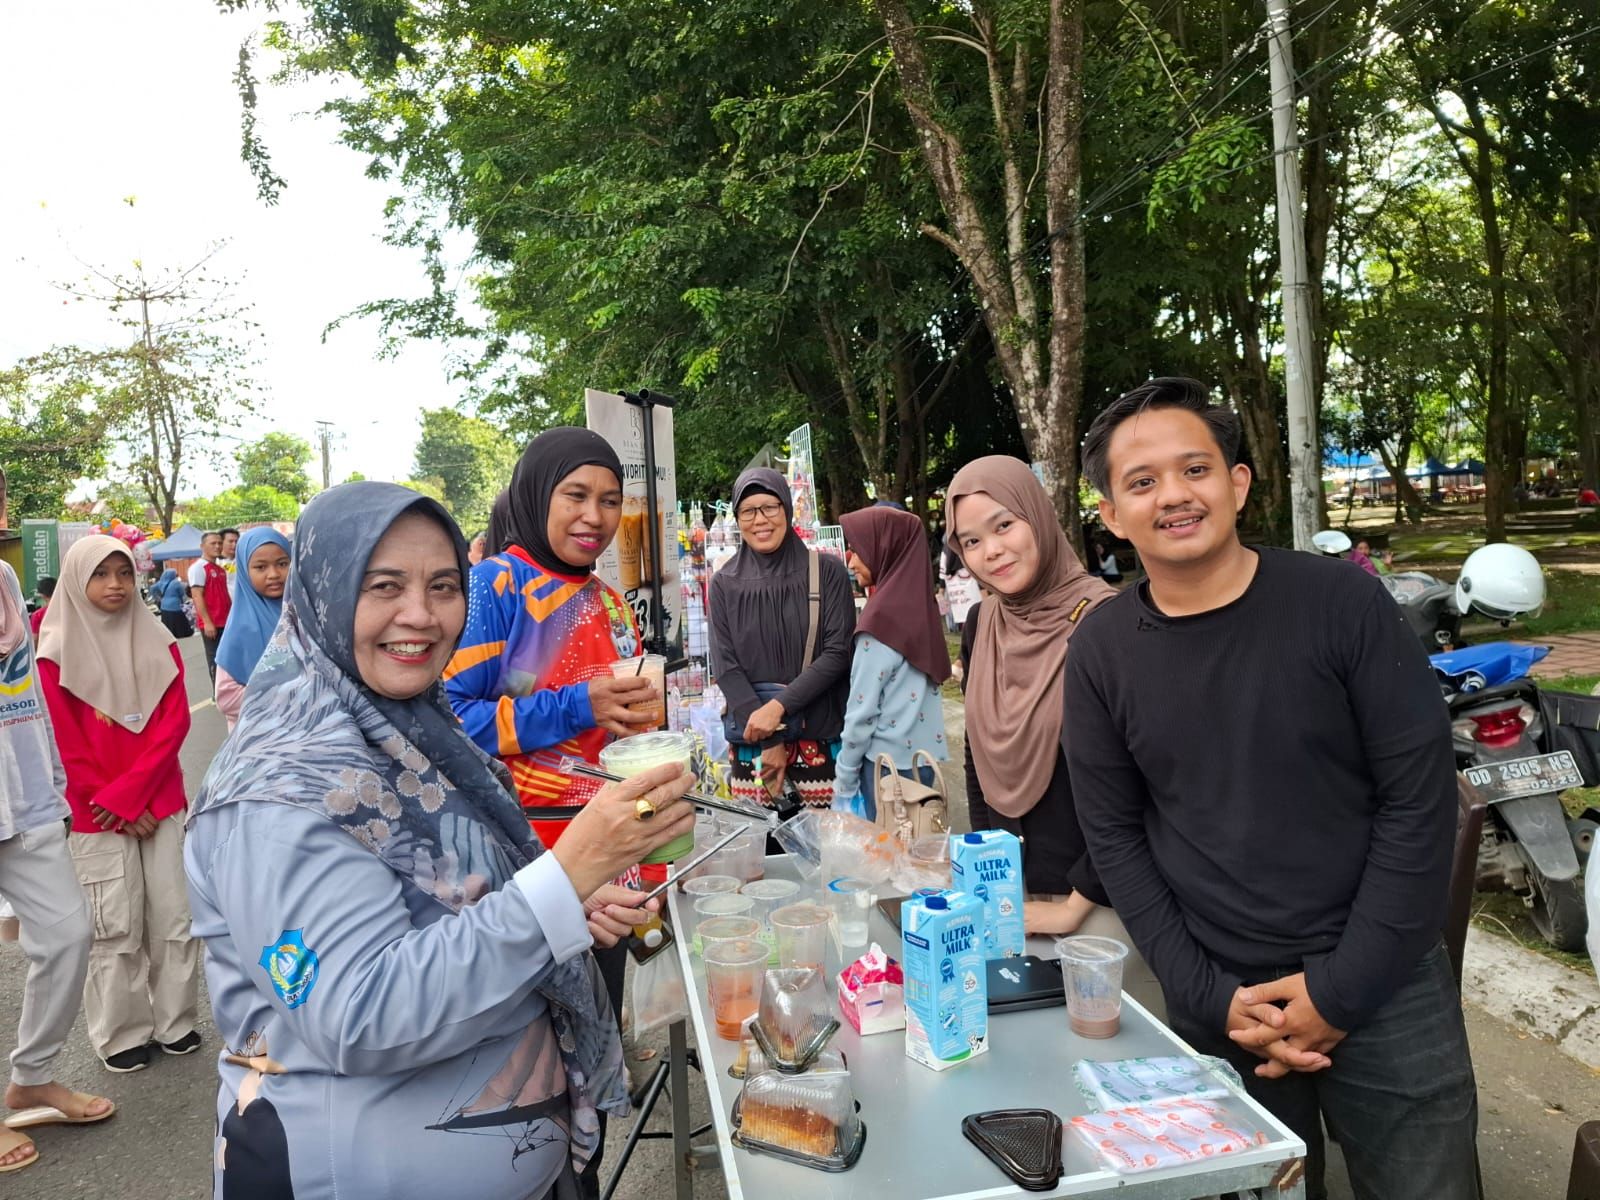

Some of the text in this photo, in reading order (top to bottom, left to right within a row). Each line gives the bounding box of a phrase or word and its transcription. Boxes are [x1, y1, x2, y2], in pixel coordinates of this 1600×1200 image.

[0, 698, 36, 713] eason
[1467, 768, 1492, 787] DD
[1498, 759, 1542, 781] 2505
[973, 857, 1012, 873] ULTRA
[941, 923, 975, 945] ULTRA
